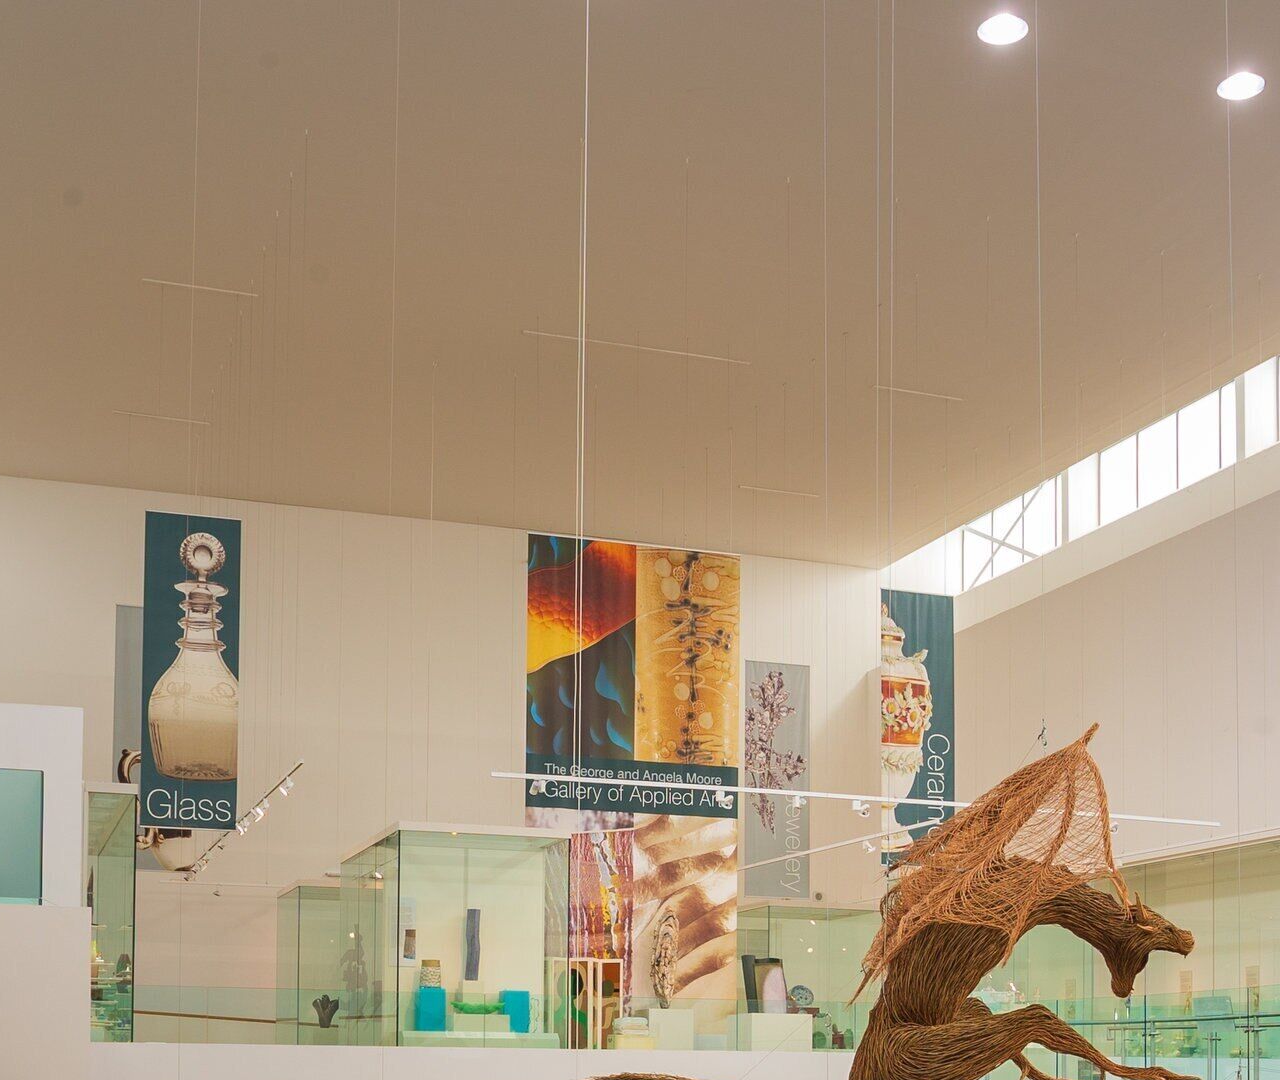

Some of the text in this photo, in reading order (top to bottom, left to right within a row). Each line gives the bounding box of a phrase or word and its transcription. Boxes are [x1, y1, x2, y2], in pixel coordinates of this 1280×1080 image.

[544, 763, 722, 785] The George and Angela Moore
[146, 788, 231, 823] Glass
[544, 780, 602, 805] Gallery
[607, 784, 624, 802] of
[629, 786, 694, 808] Applied
[927, 733, 950, 857] Ceramc
